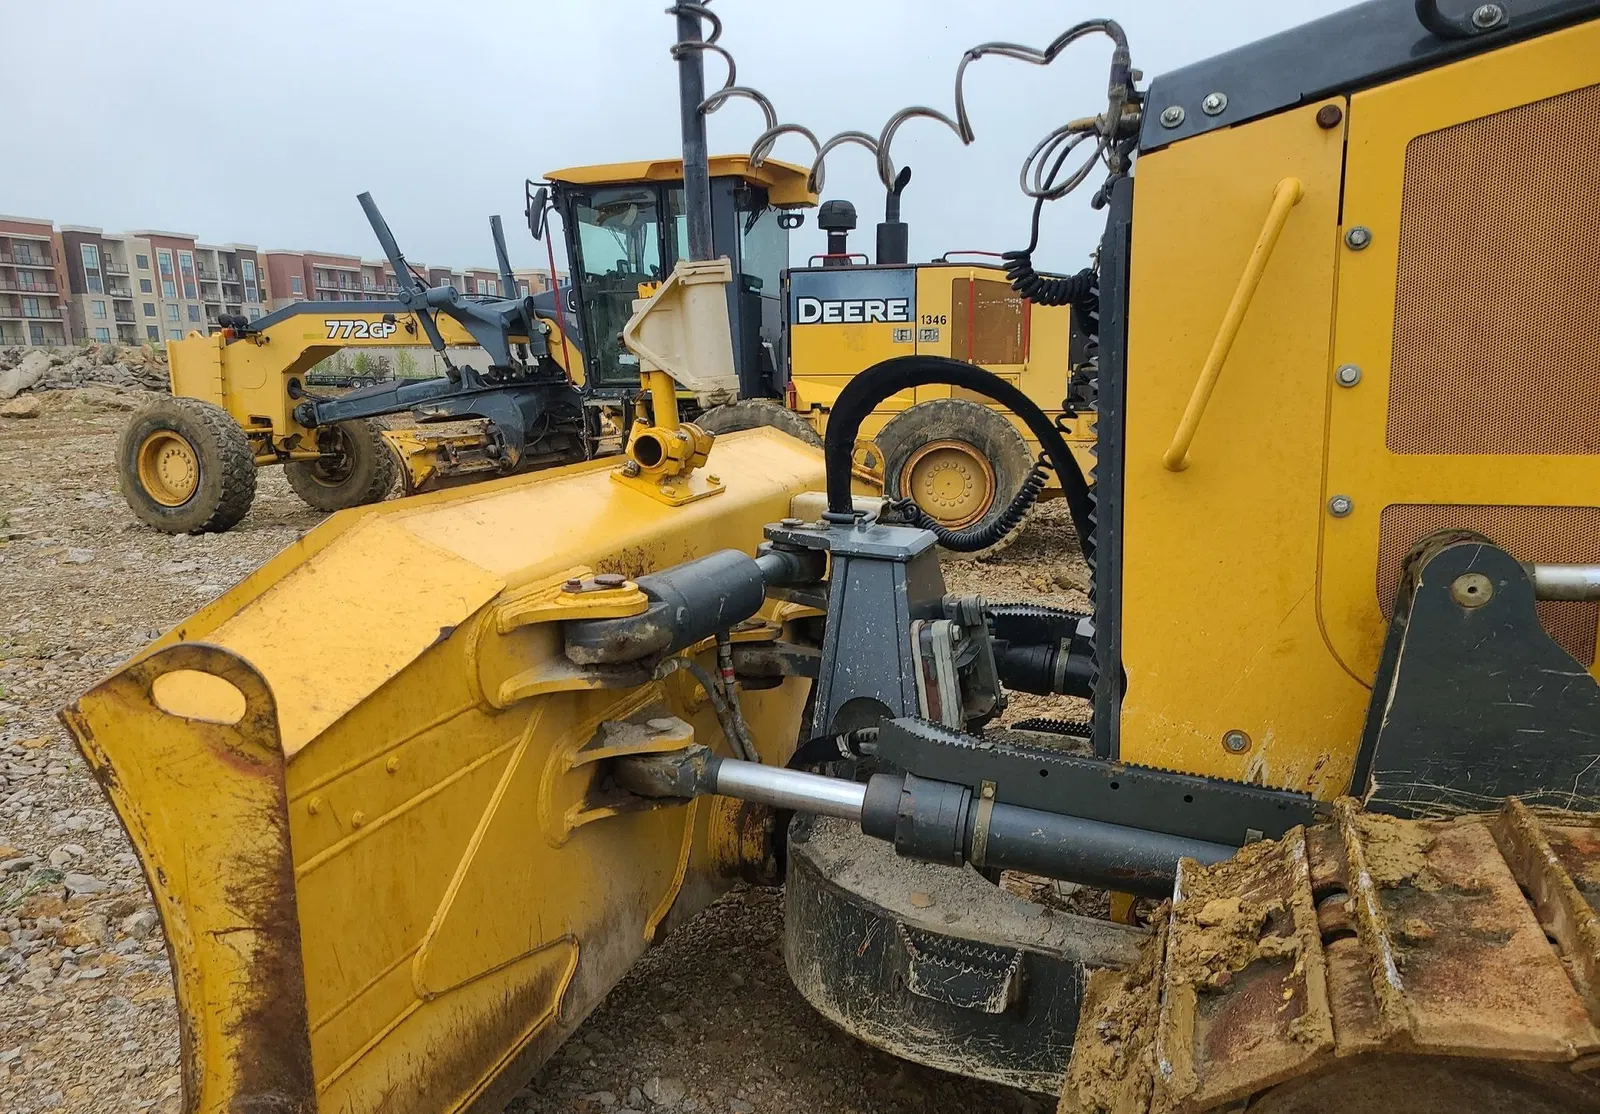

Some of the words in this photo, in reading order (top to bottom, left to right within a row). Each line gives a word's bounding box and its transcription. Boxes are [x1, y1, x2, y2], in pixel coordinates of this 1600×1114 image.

[798, 297, 908, 323] DEERE
[325, 320, 396, 338] 772GP
[921, 315, 947, 325] 1346
